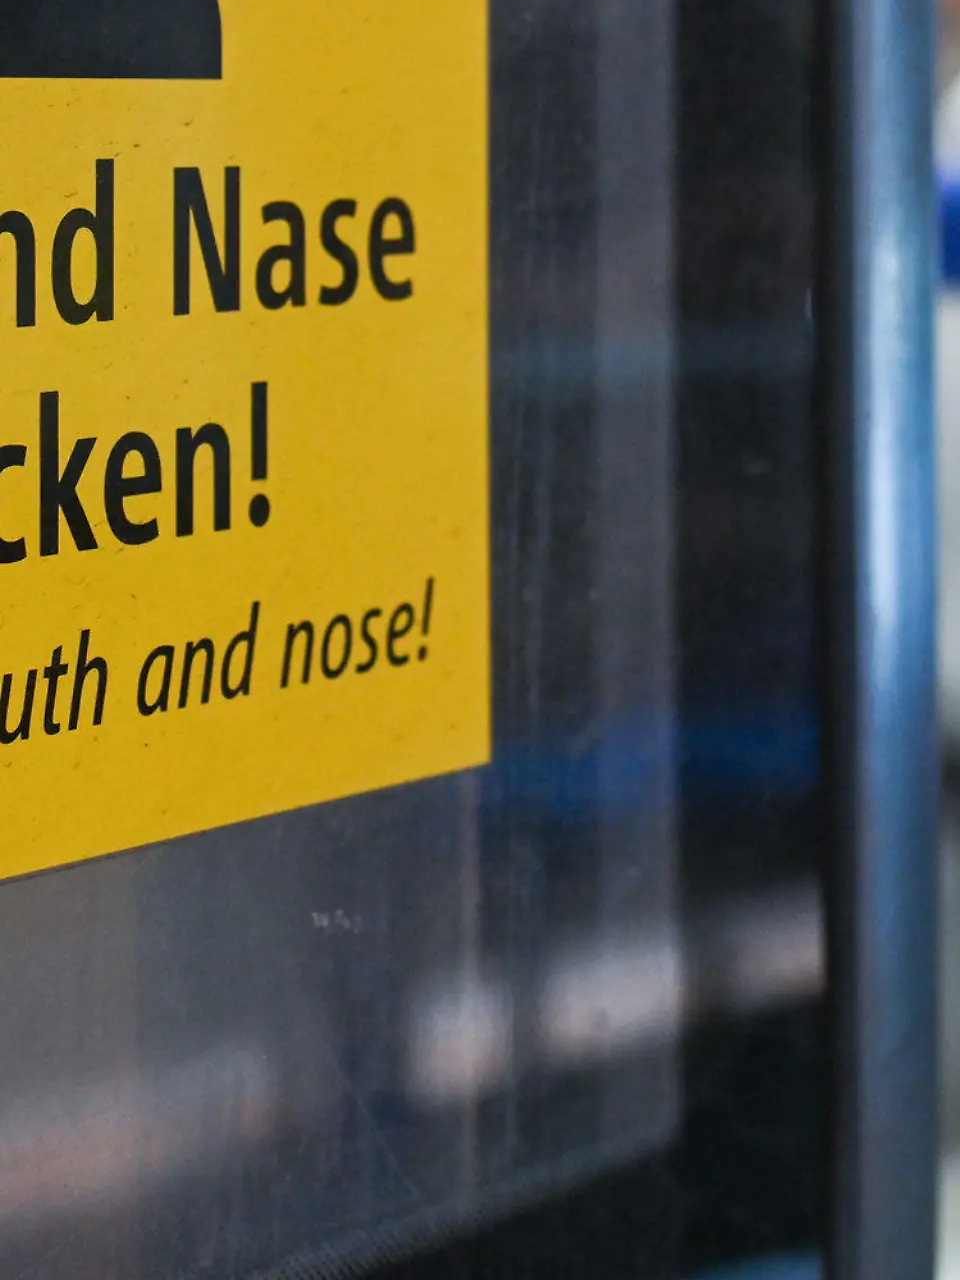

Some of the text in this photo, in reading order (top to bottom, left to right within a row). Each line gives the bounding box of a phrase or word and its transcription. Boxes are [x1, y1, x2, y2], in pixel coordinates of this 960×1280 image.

[173, 165, 417, 317] Nase
[0, 576, 436, 746] uth and nose!
